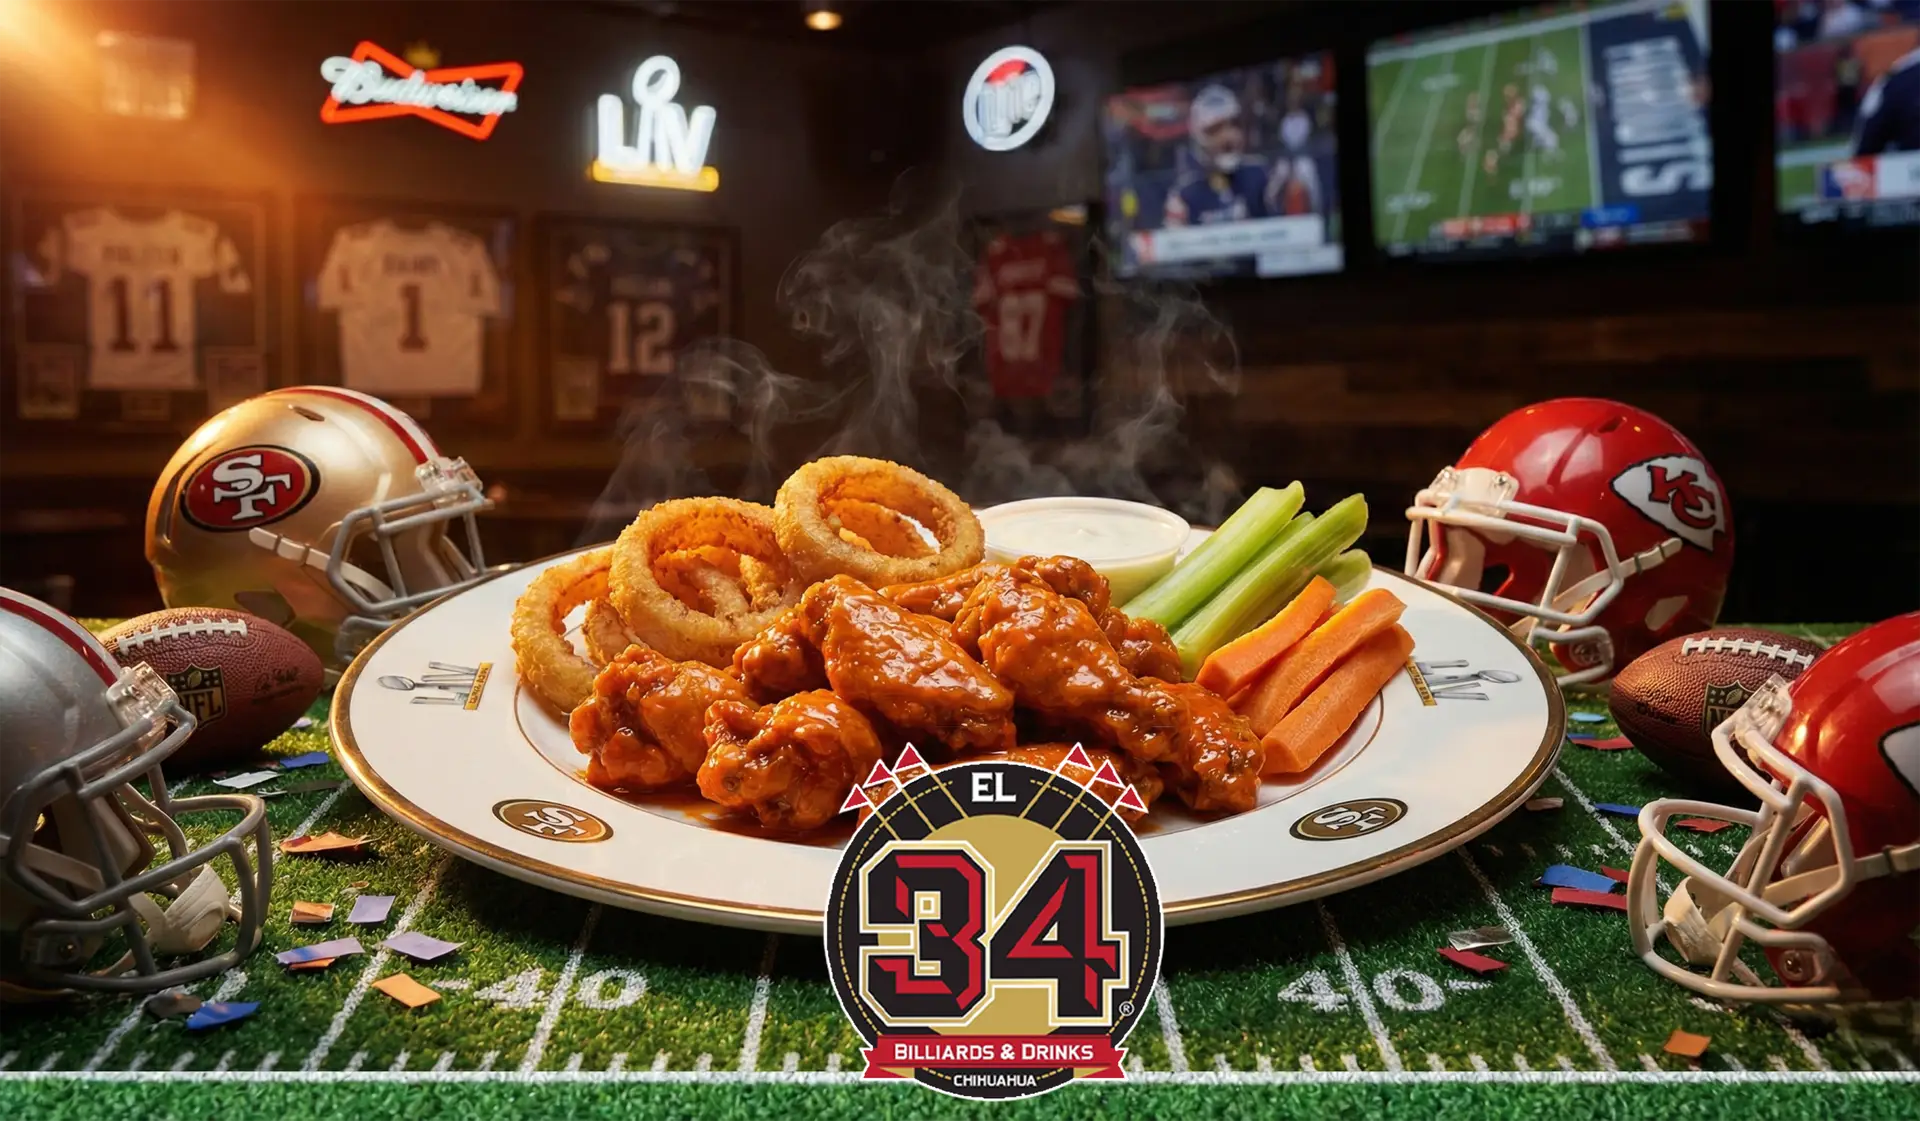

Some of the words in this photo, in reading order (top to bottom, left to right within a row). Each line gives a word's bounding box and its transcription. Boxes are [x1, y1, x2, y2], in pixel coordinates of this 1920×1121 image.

[108, 275, 179, 352] 11
[397, 283, 430, 352] 1
[606, 302, 675, 374] 12
[1647, 465, 1716, 529] KC
